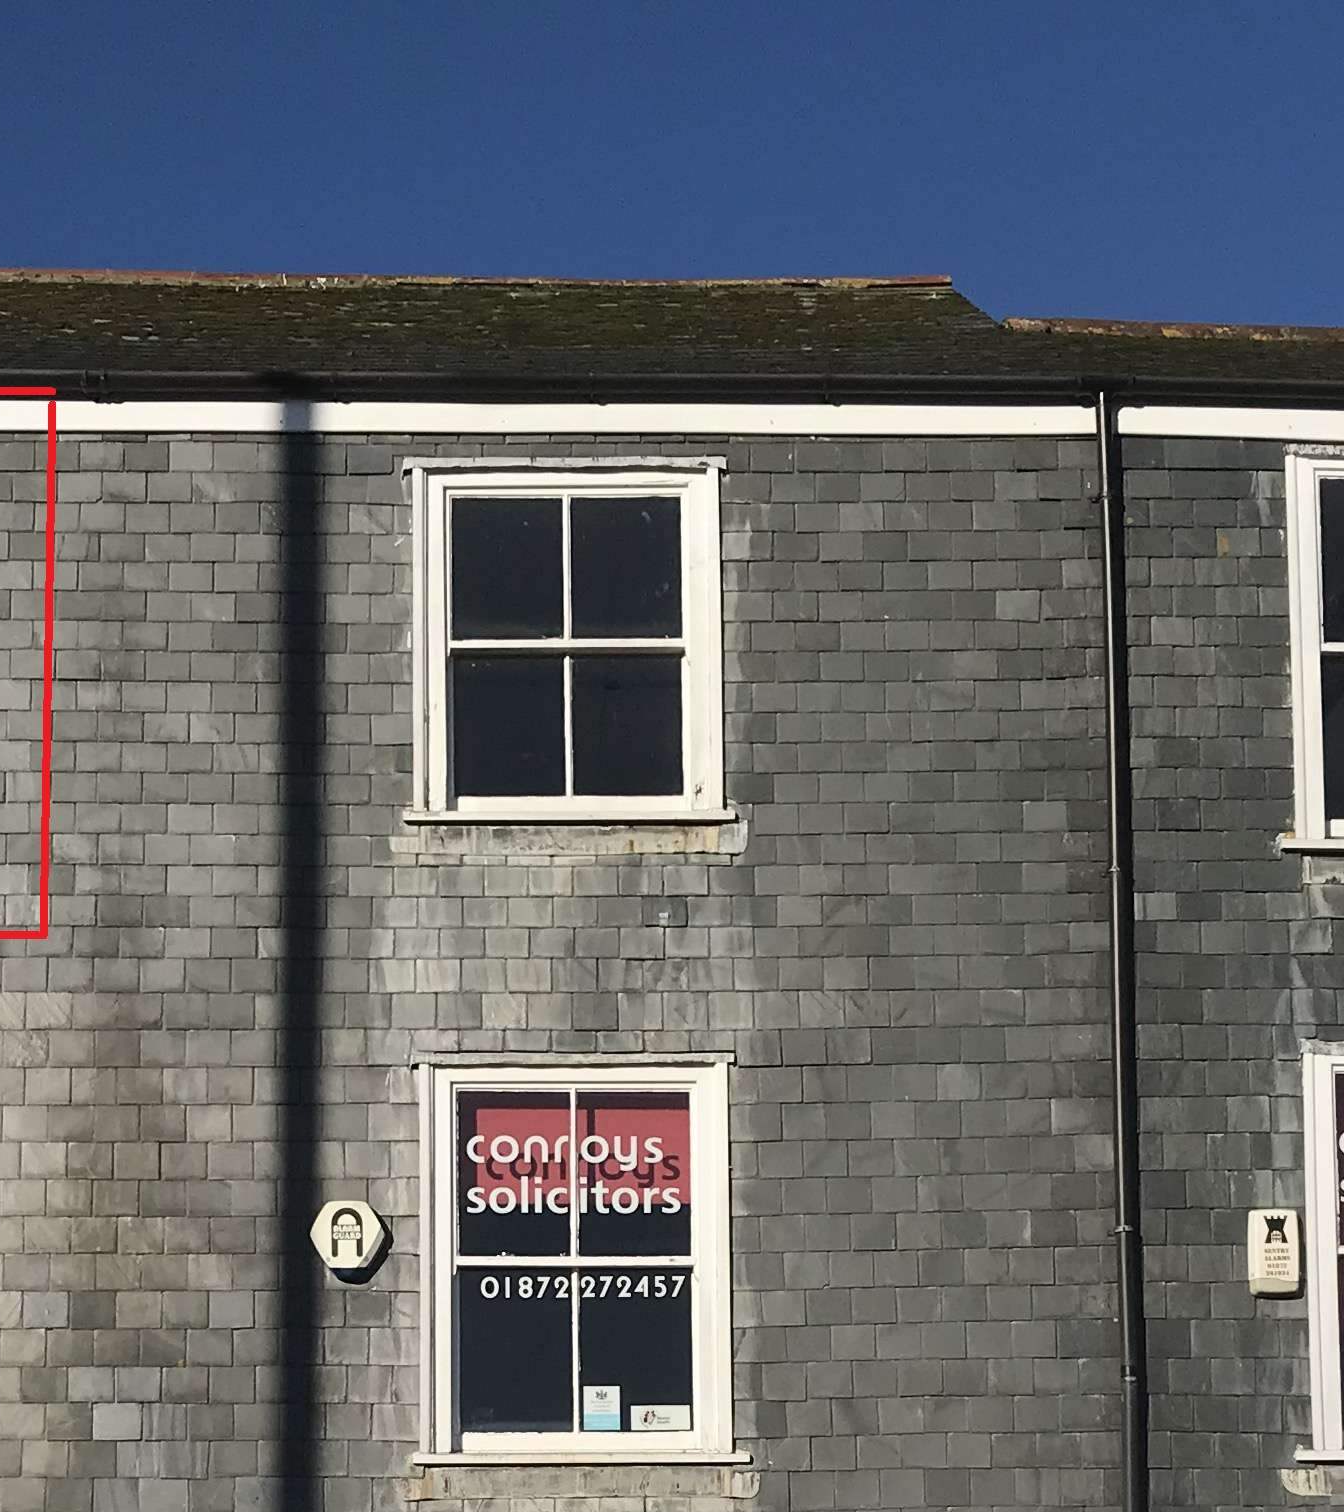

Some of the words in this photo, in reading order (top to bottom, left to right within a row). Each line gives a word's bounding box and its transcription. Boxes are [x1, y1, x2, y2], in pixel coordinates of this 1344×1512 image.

[466, 1134, 664, 1170] conroys
[466, 1177, 682, 1214] solicitors
[333, 1232, 362, 1240] GUARD
[480, 1275, 569, 1299] 01872
[580, 1275, 686, 1299] 272457
